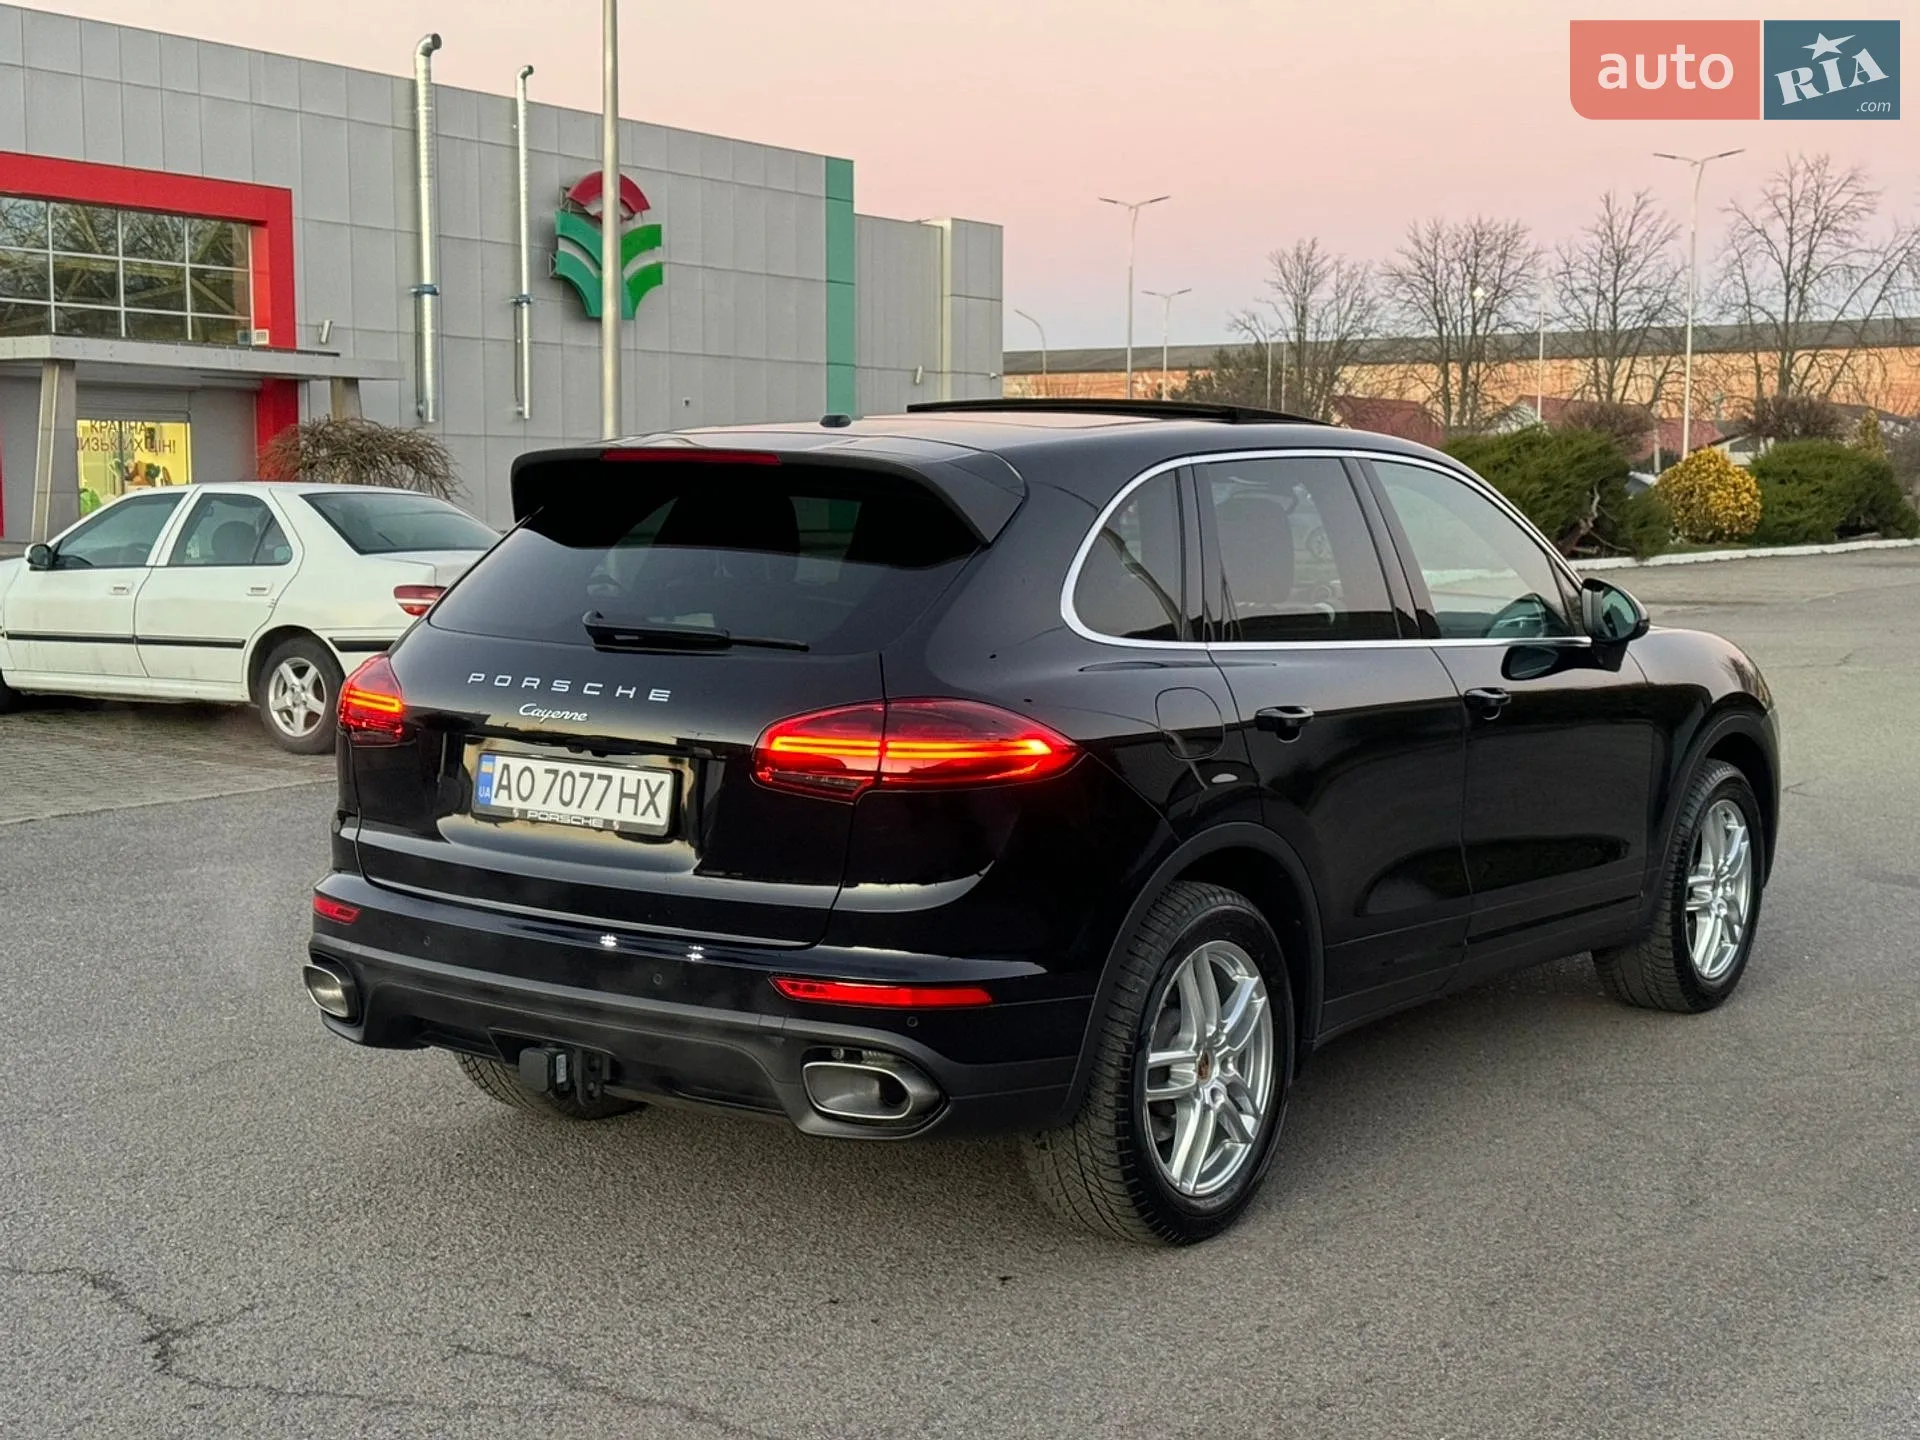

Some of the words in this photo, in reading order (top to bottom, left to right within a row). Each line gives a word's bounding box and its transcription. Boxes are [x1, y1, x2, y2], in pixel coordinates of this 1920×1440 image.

[76, 437, 144, 453] ИЗЬКИХ
[467, 672, 672, 702] PORSCHE
[518, 702, 590, 724] Cayenne
[478, 786, 490, 800] UA
[494, 763, 535, 803] AO
[542, 768, 613, 812] 7077
[617, 776, 665, 818] HX
[526, 809, 604, 828] PORSCHE
